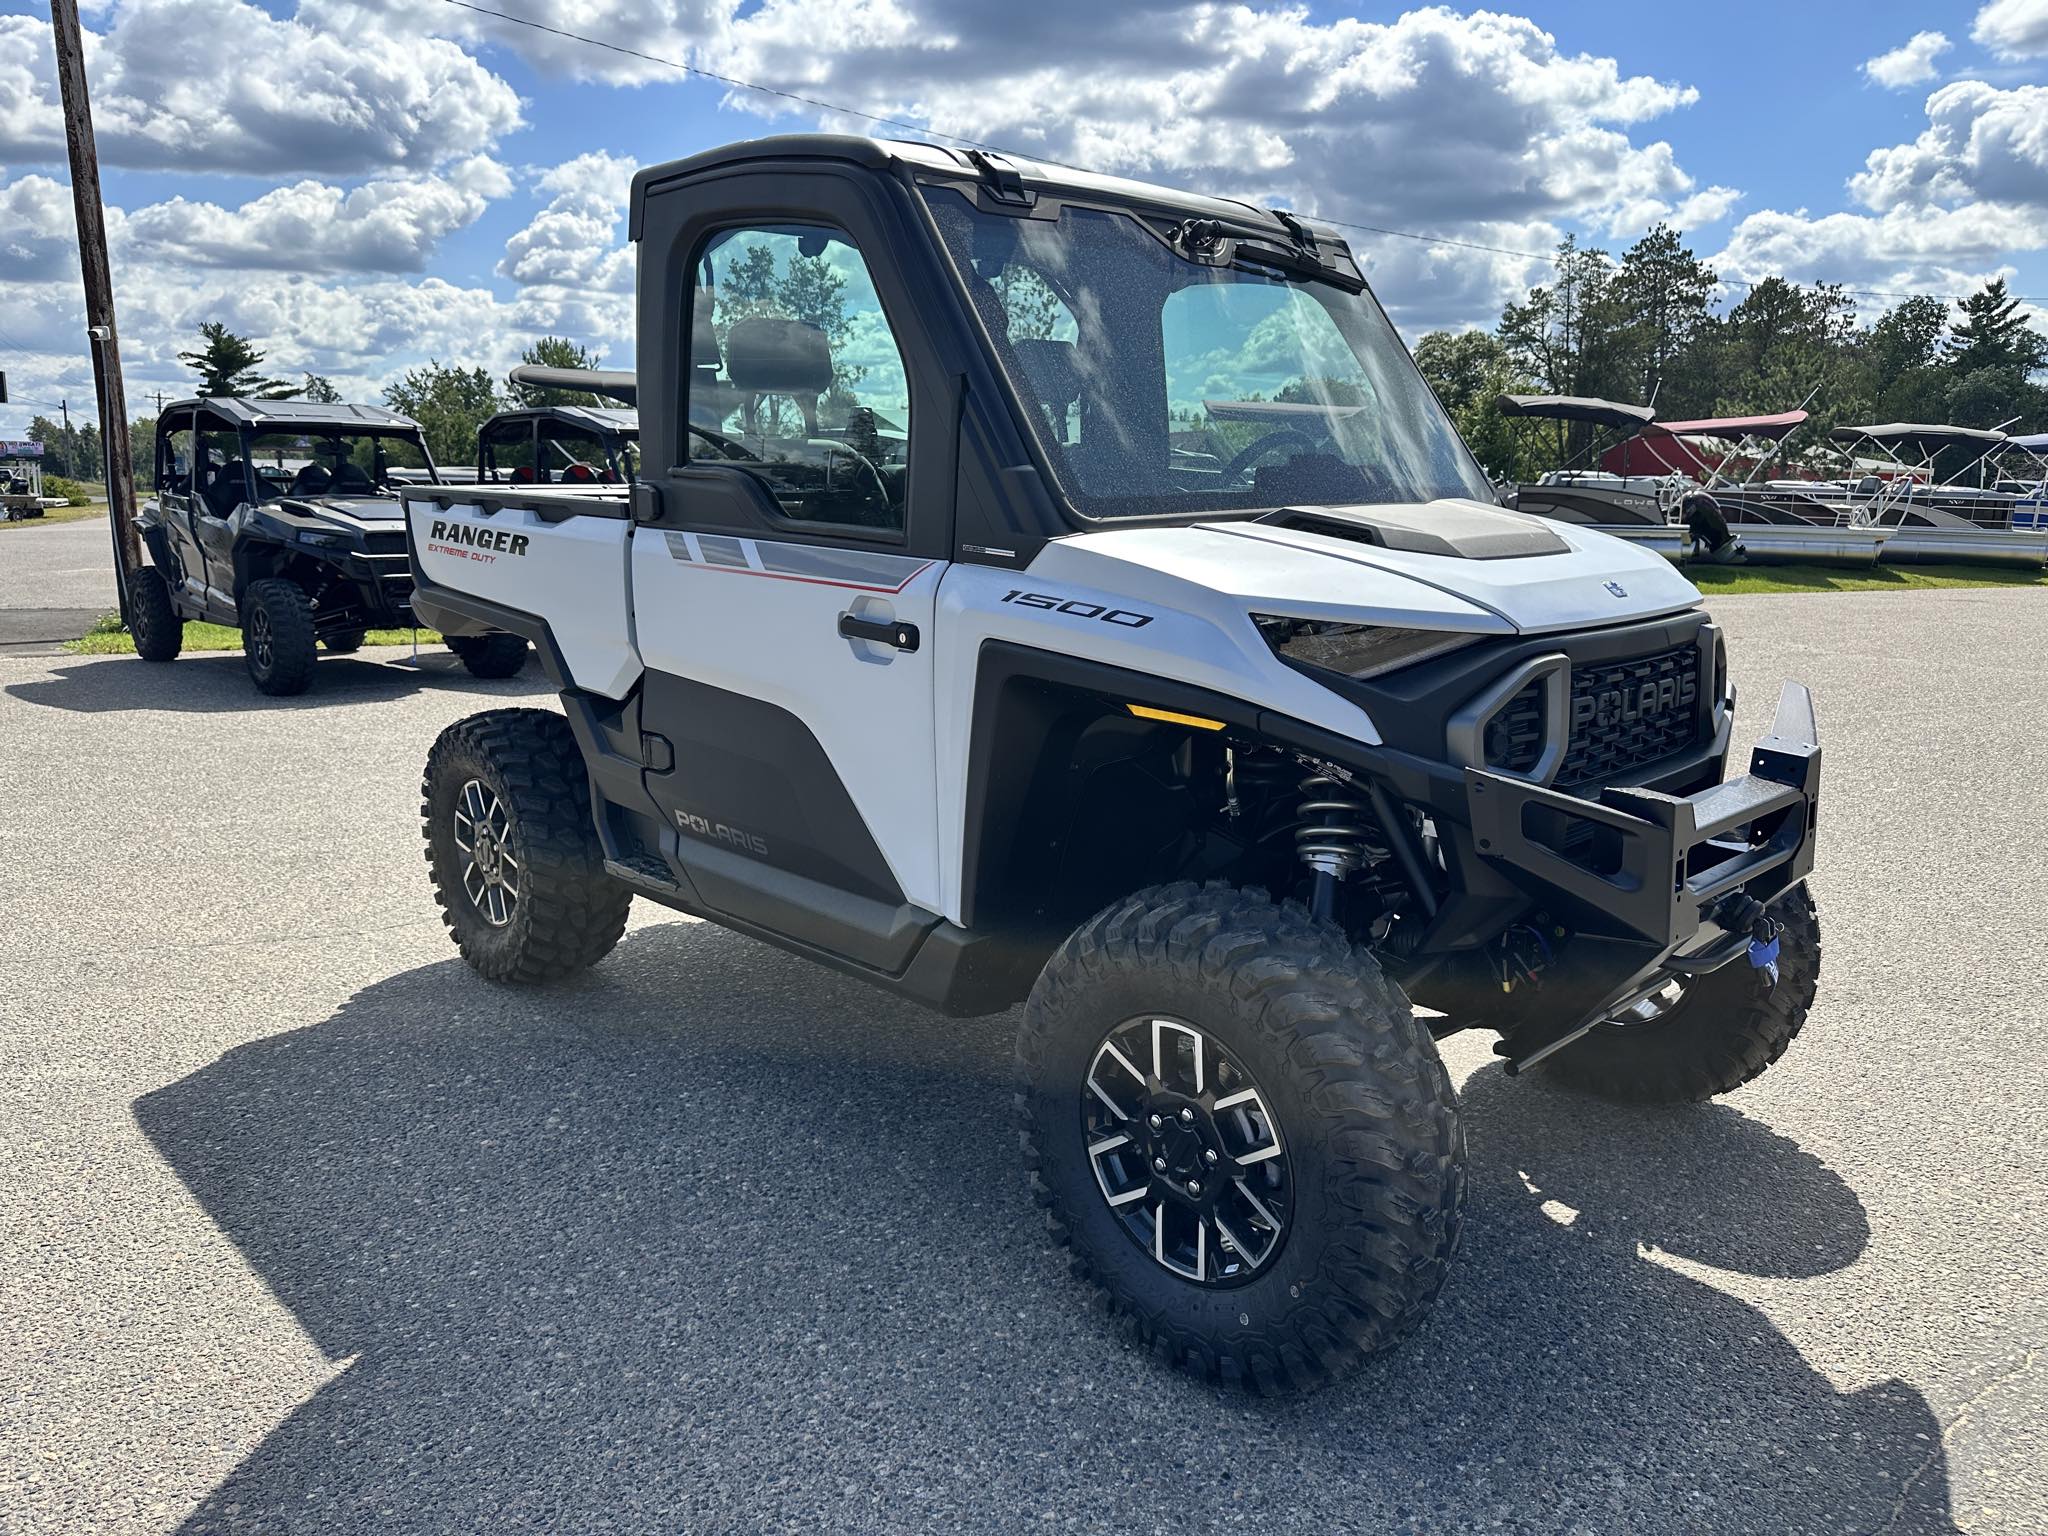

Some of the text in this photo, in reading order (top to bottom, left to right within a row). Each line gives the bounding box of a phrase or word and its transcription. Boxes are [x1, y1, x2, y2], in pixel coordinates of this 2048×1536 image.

[427, 543, 497, 565] EXTREME DUTY
[430, 520, 530, 556] RANGER
[1001, 589, 1154, 629] 1500
[1570, 671, 1697, 736] POLARIS
[674, 808, 769, 856] POLARIS
